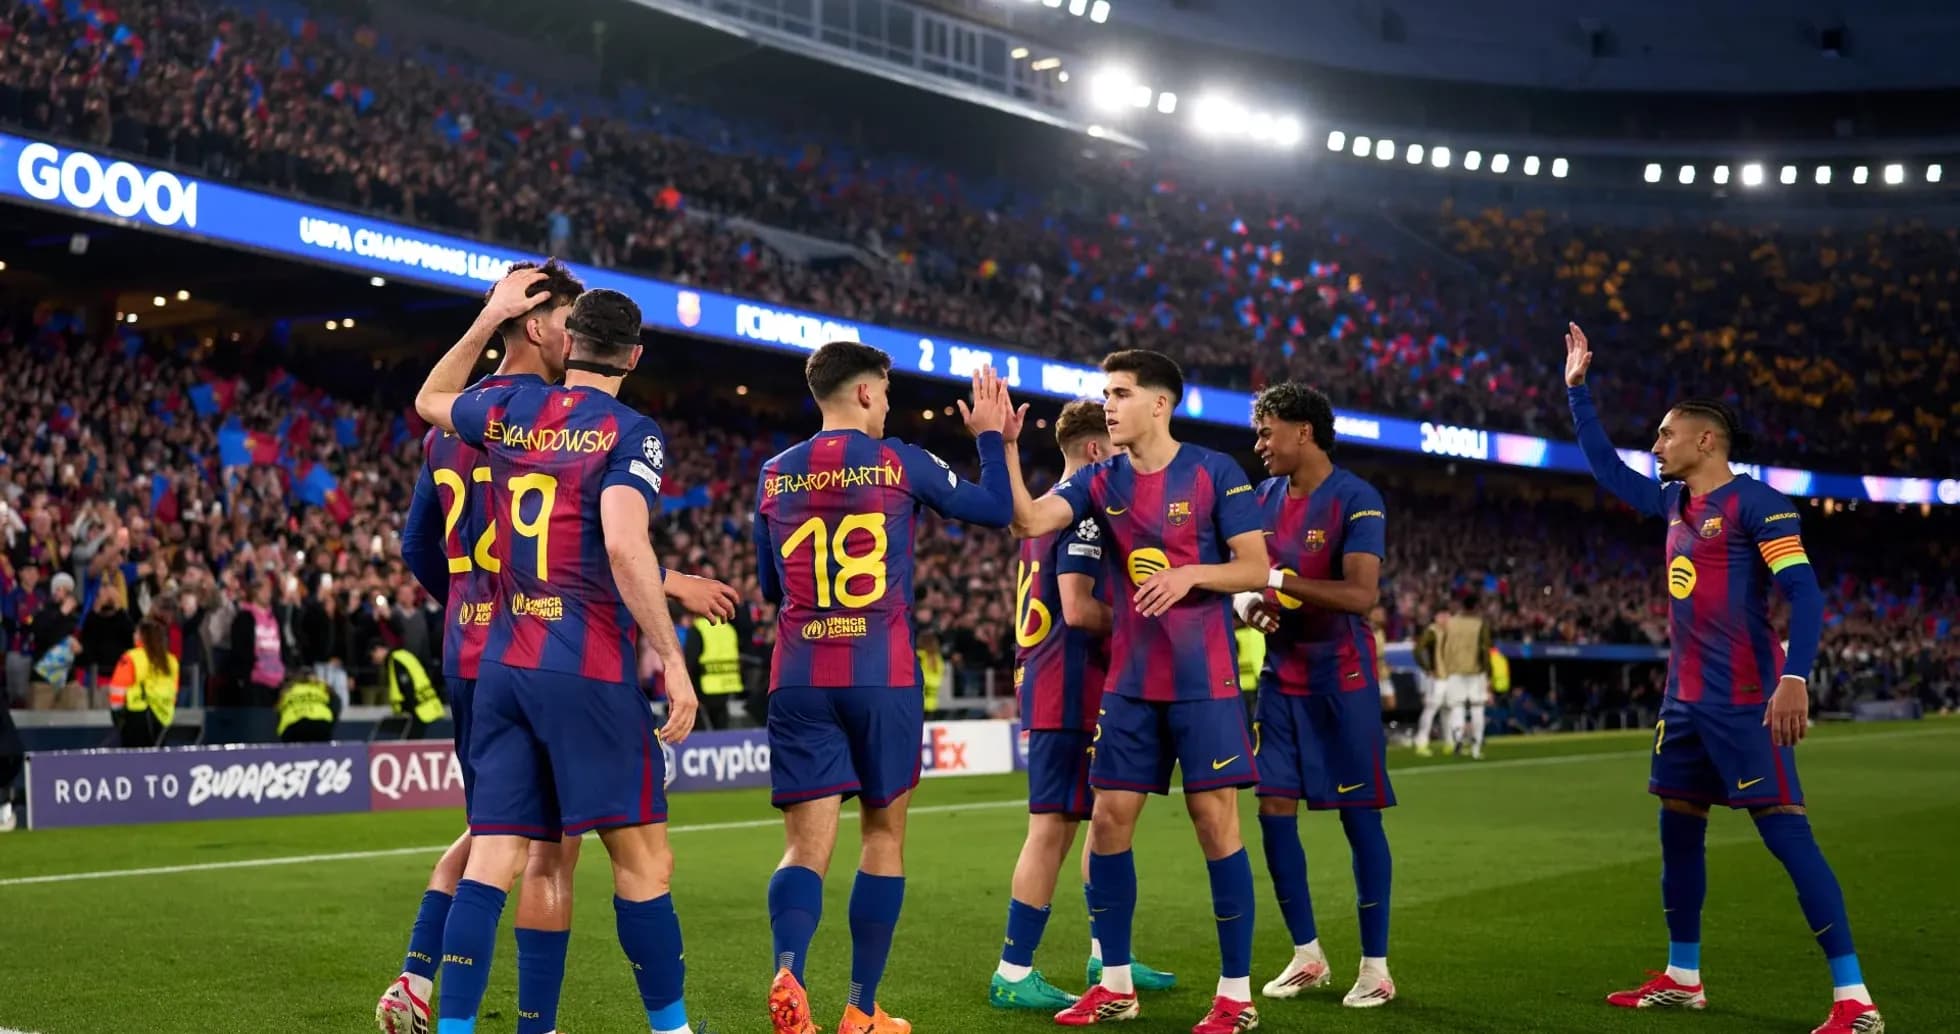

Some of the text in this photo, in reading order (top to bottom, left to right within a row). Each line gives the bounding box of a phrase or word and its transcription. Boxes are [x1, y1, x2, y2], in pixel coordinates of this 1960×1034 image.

[917, 338, 936, 372] 2
[1006, 356, 1021, 387] 1
[484, 418, 617, 453] EWANDOWSKI
[508, 472, 557, 582] 9
[781, 512, 888, 608] 18
[826, 617, 866, 627] UNHCR
[828, 625, 867, 635] ACNUR
[682, 739, 771, 782] crypto
[55, 758, 352, 806] ROAD TO BUDAPEST 26
